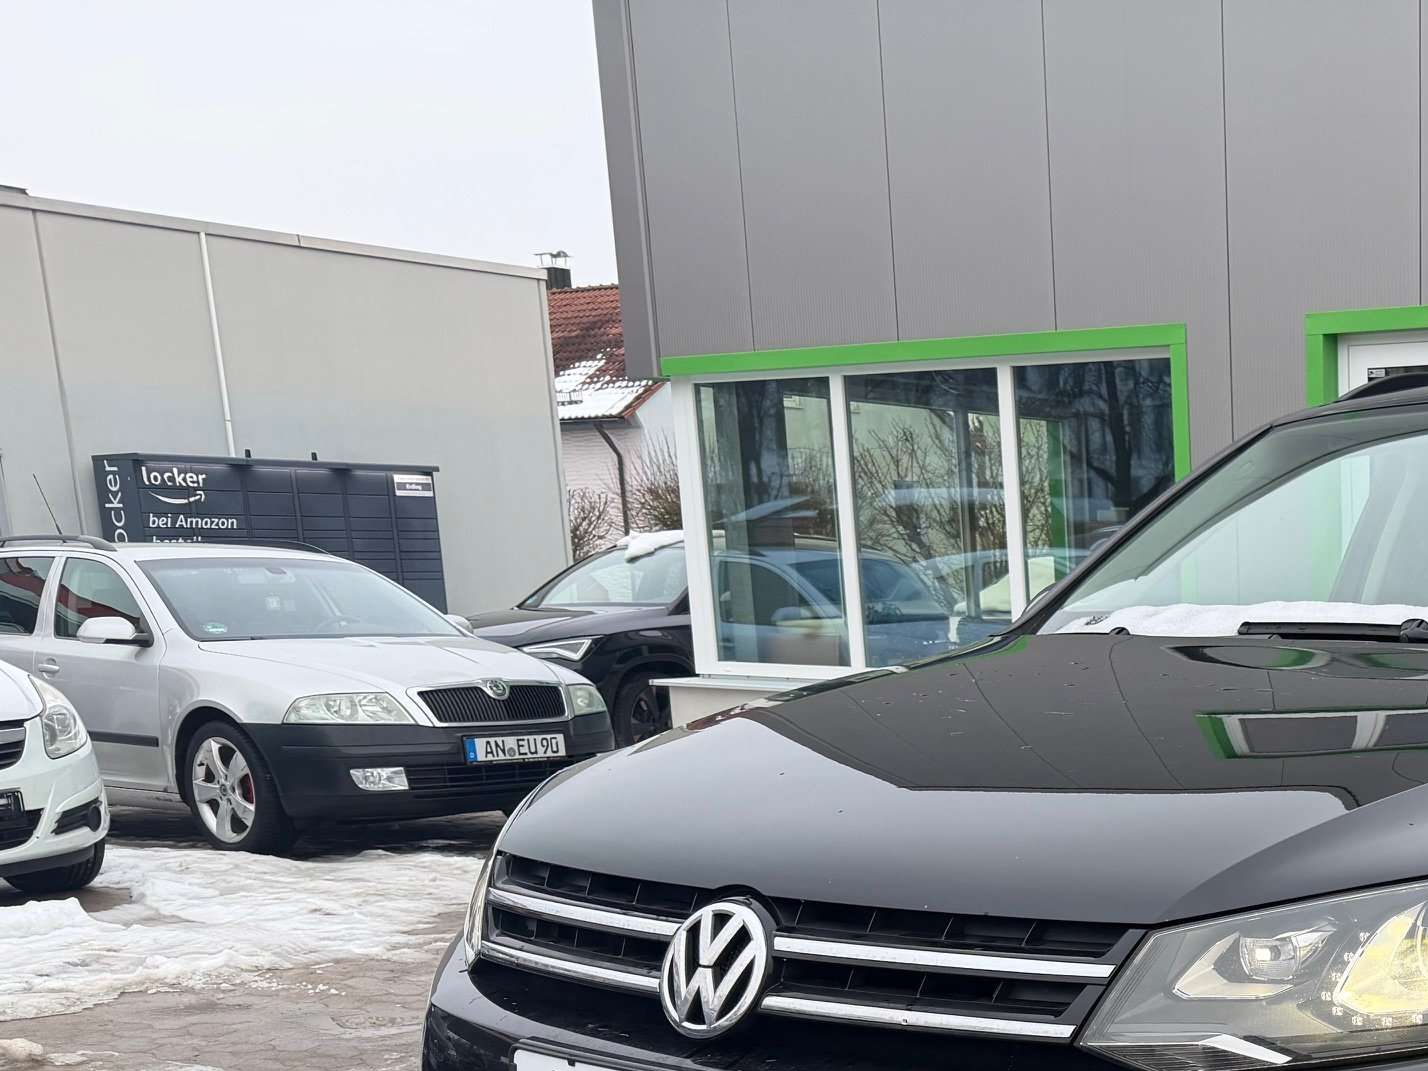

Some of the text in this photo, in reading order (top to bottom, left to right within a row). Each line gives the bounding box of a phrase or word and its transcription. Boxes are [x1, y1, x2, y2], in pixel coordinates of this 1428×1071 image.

[141, 466, 207, 487] locker
[149, 513, 237, 529] bei Amazon
[485, 739, 506, 758] AN
[516, 738, 538, 756] EU
